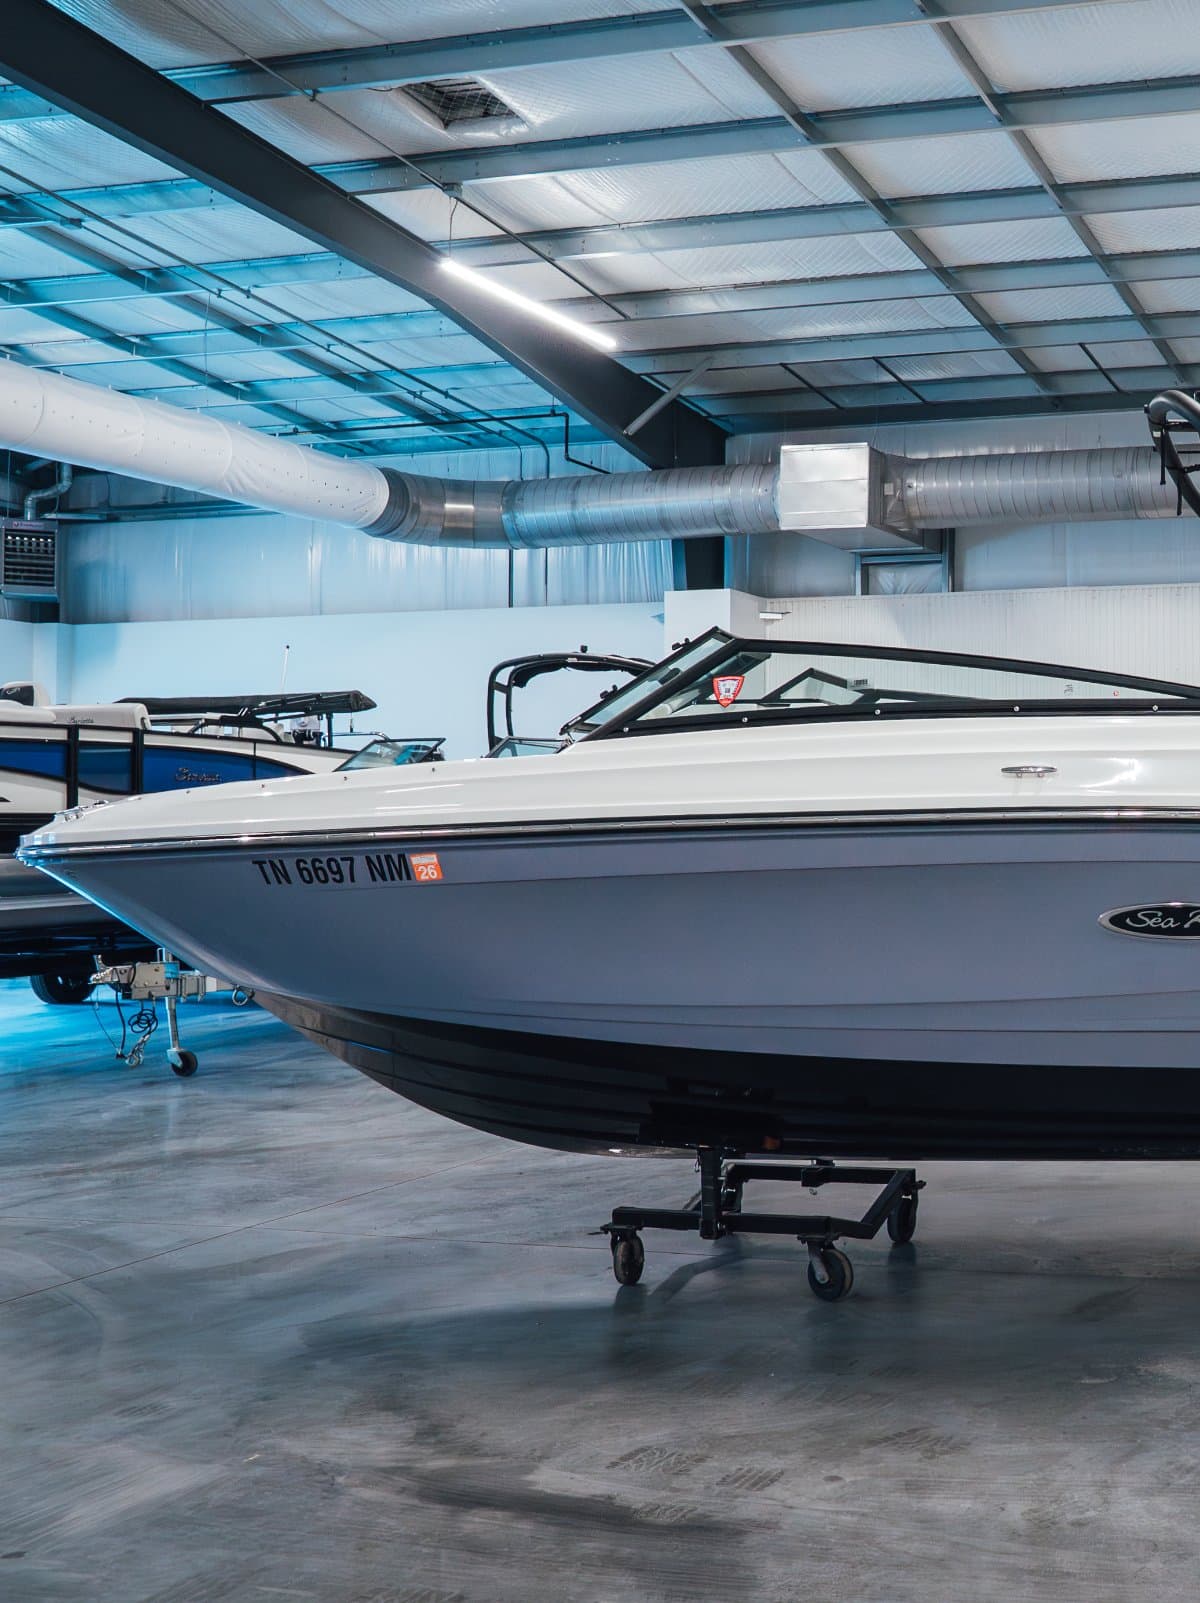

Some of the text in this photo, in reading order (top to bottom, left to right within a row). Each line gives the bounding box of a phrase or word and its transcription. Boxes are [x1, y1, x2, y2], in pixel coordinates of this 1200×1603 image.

[252, 853, 412, 884] TN 6697 NM
[418, 865, 437, 879] 26
[1126, 911, 1180, 928] Sea
